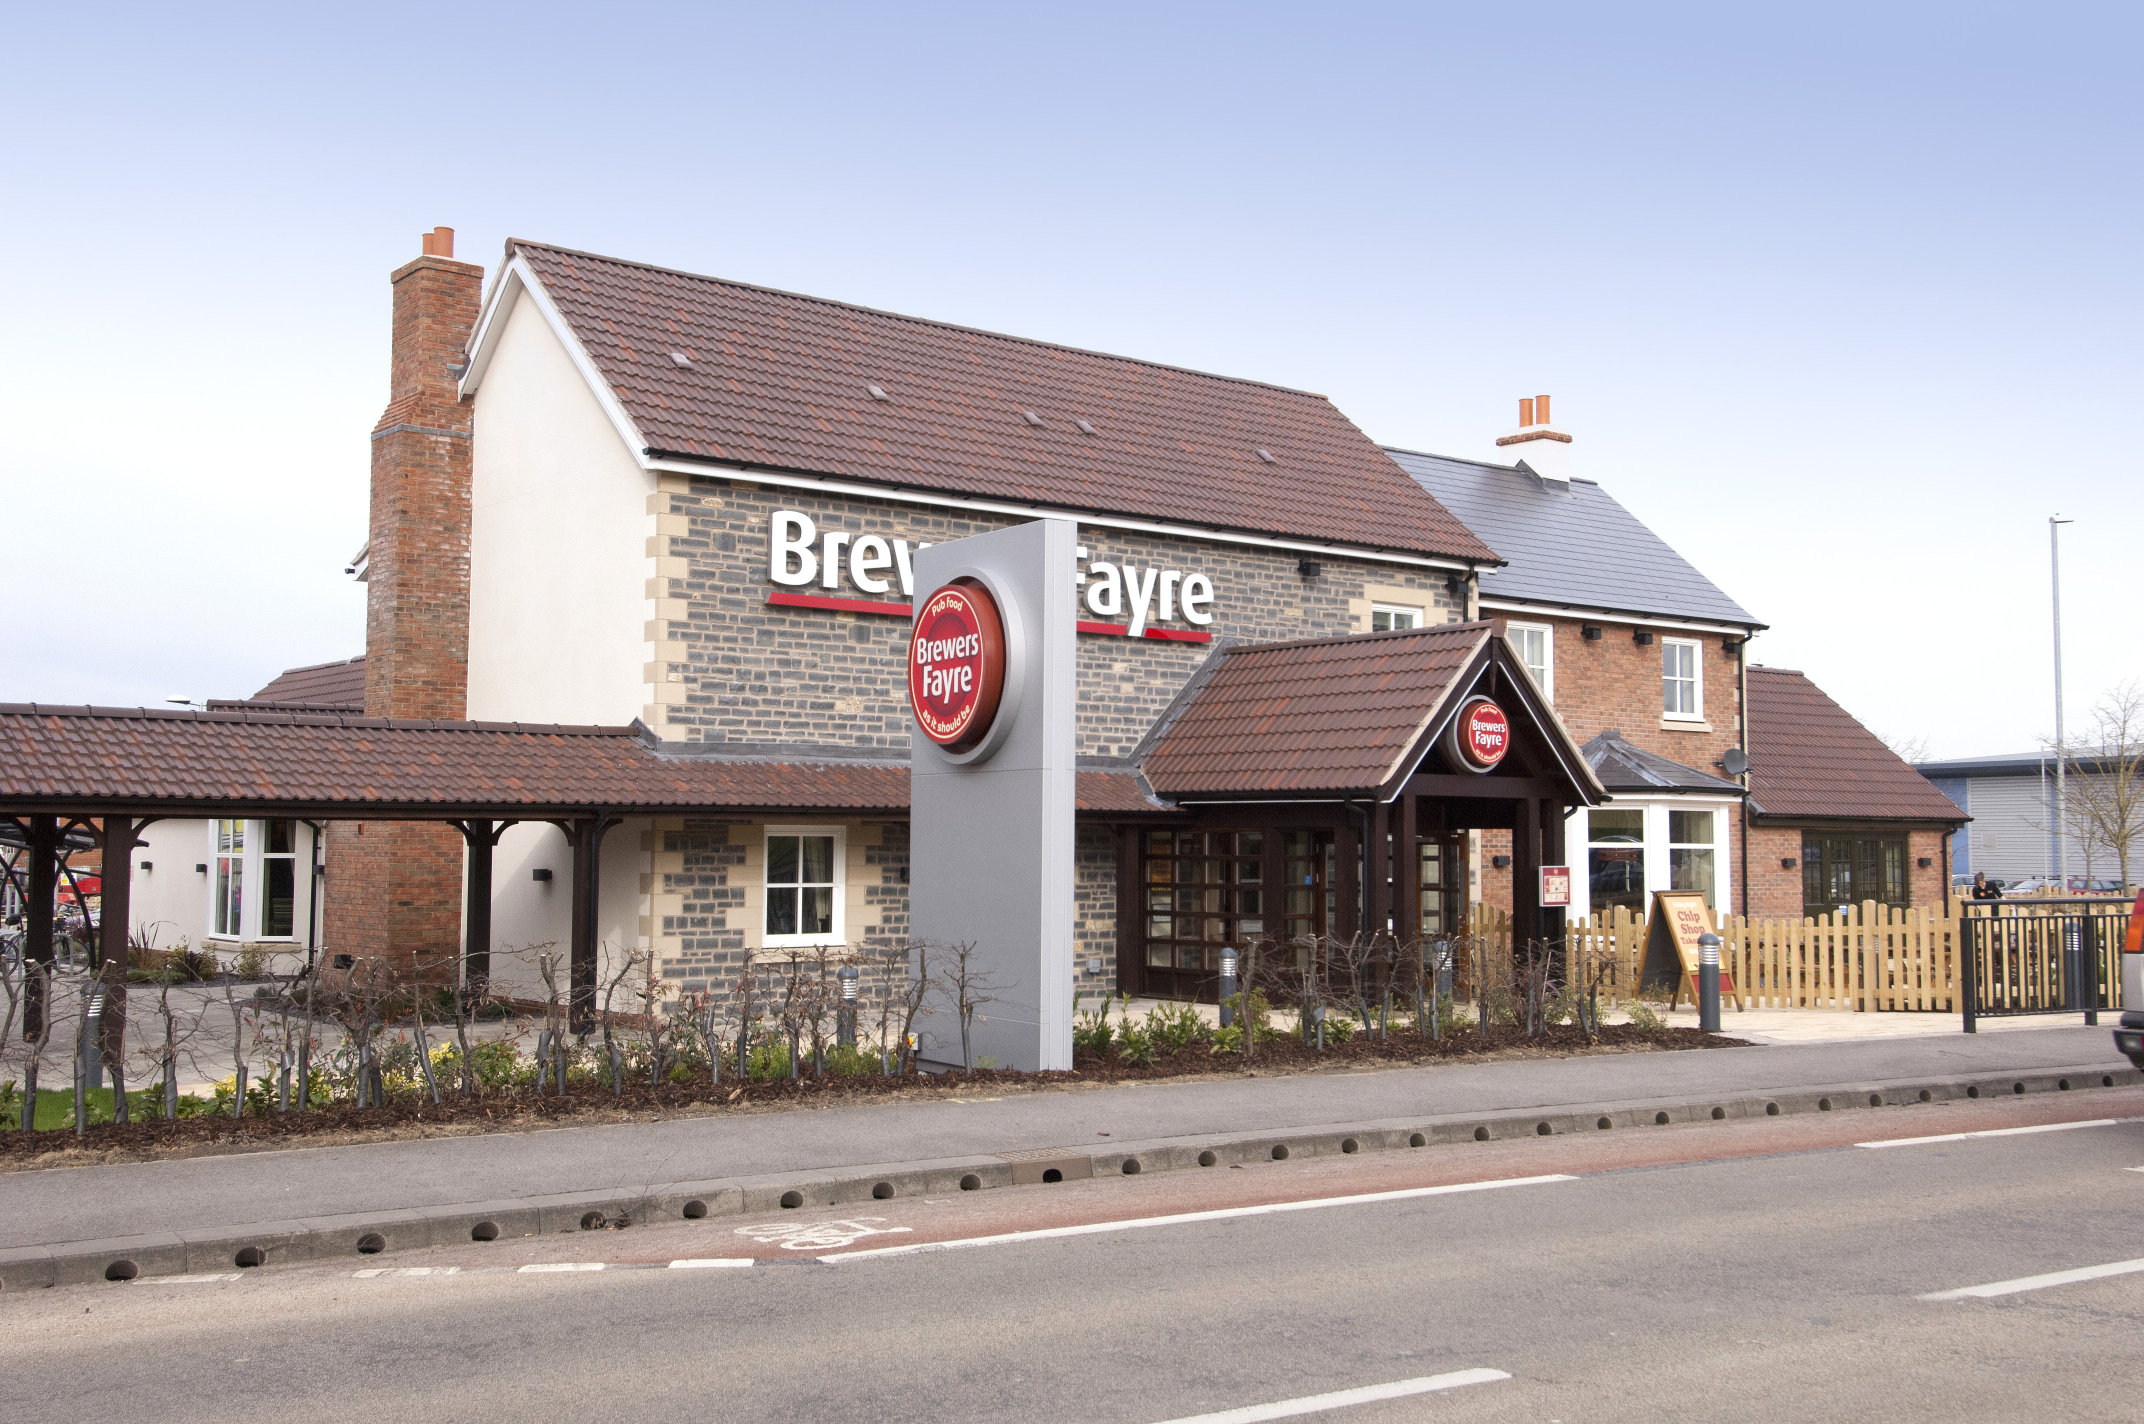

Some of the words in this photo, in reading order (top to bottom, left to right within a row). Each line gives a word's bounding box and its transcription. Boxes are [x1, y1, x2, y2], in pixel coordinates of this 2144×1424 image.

[931, 599, 946, 617] Pub
[946, 596, 963, 612] food
[916, 633, 979, 665] Brewers
[923, 665, 972, 705] Fayre
[922, 709, 931, 724] as
[930, 716, 937, 730] it
[937, 714, 962, 733] should
[960, 704, 971, 720] be
[1472, 719, 1505, 733] Brewers
[1475, 731, 1502, 748] Fayre
[1677, 910, 1700, 923] Chip
[1680, 923, 1705, 937] Shop
